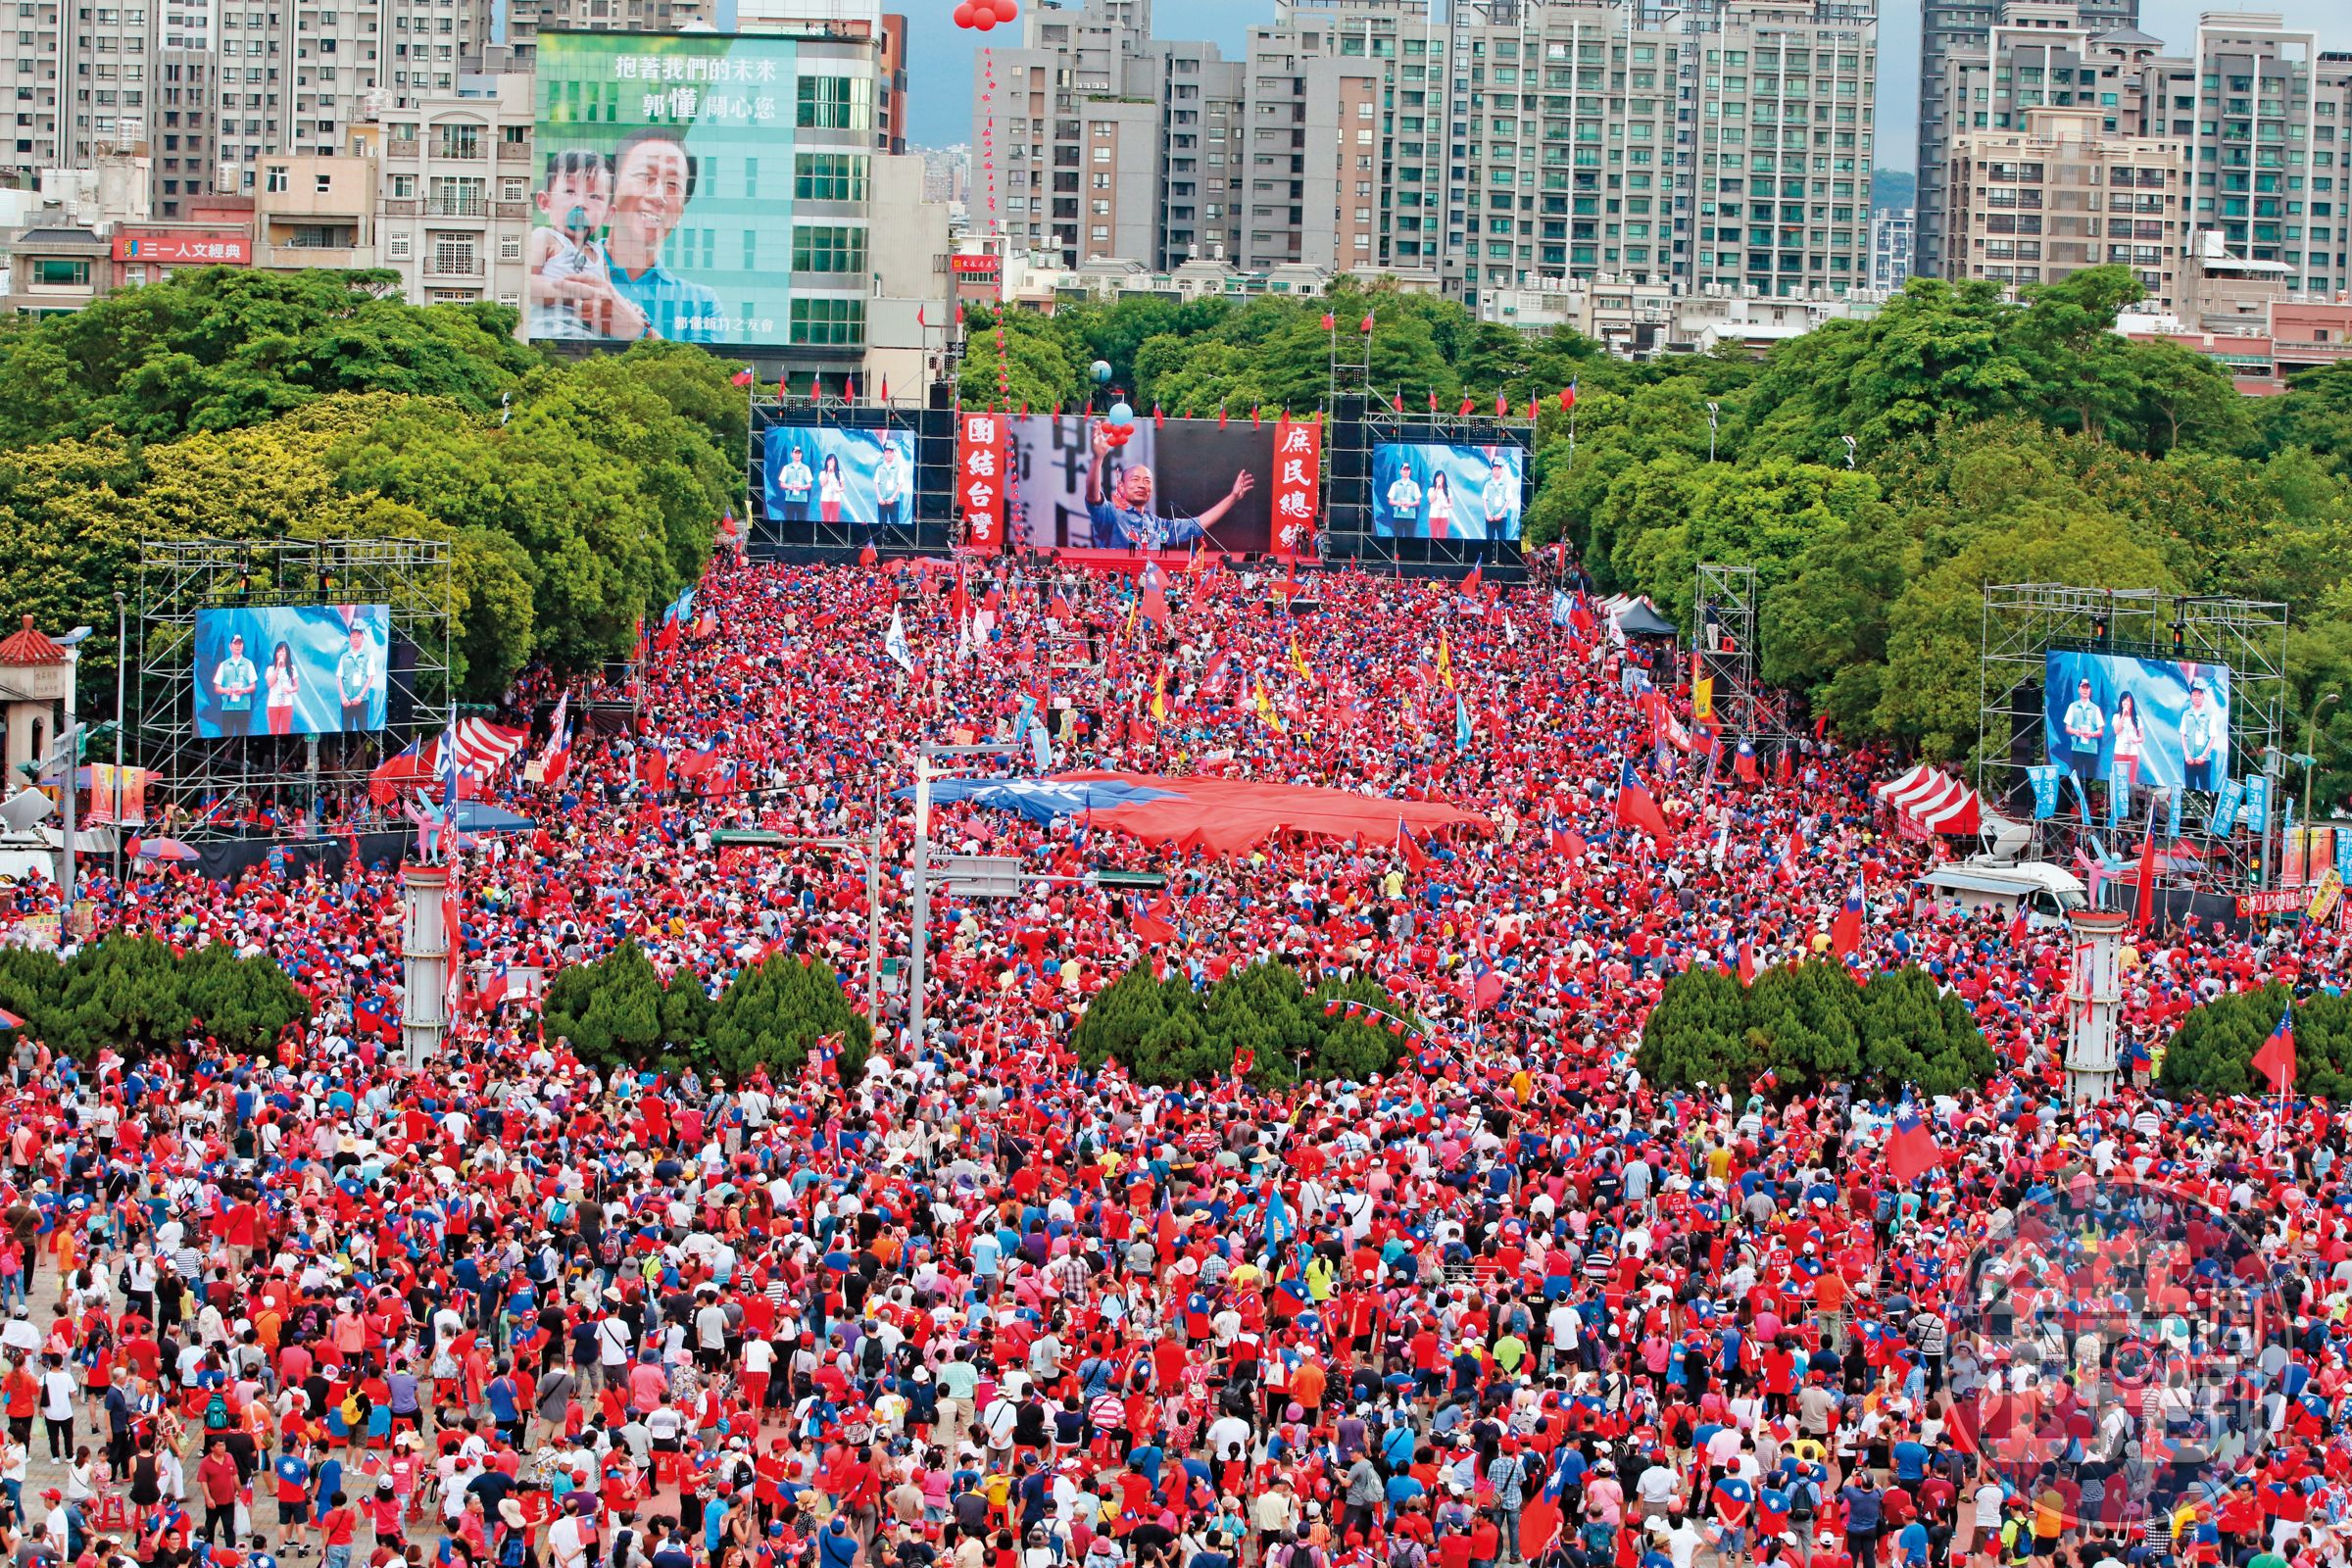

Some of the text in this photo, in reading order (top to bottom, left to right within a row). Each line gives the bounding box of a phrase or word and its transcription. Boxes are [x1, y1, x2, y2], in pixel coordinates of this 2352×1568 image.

[615, 56, 776, 81] 抱著我們的未來
[643, 87, 698, 119] 郭懂
[142, 242, 241, 259] 三一人文經典
[967, 417, 996, 540] 團結台灣
